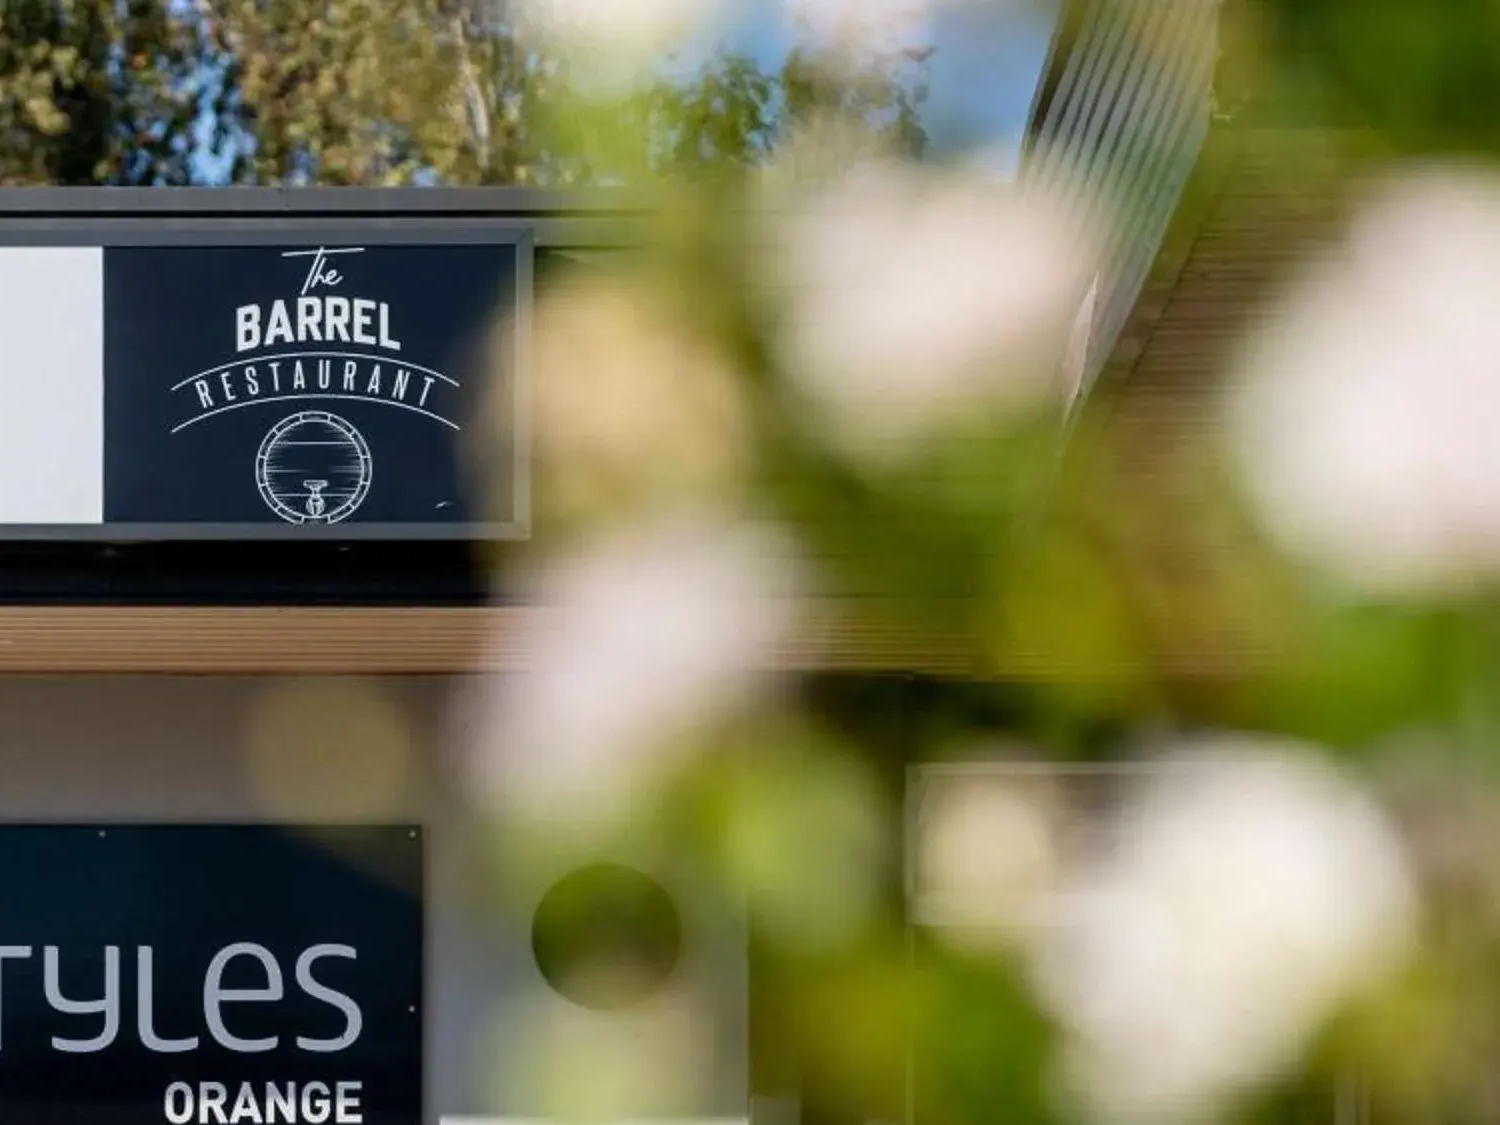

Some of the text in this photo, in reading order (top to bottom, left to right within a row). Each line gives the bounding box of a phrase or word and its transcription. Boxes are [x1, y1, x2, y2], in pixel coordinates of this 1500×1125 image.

[281, 246, 365, 295] The
[236, 297, 401, 352] BARREL
[194, 358, 437, 409] RESTAURANT
[164, 1081, 363, 1125] ORANGE
